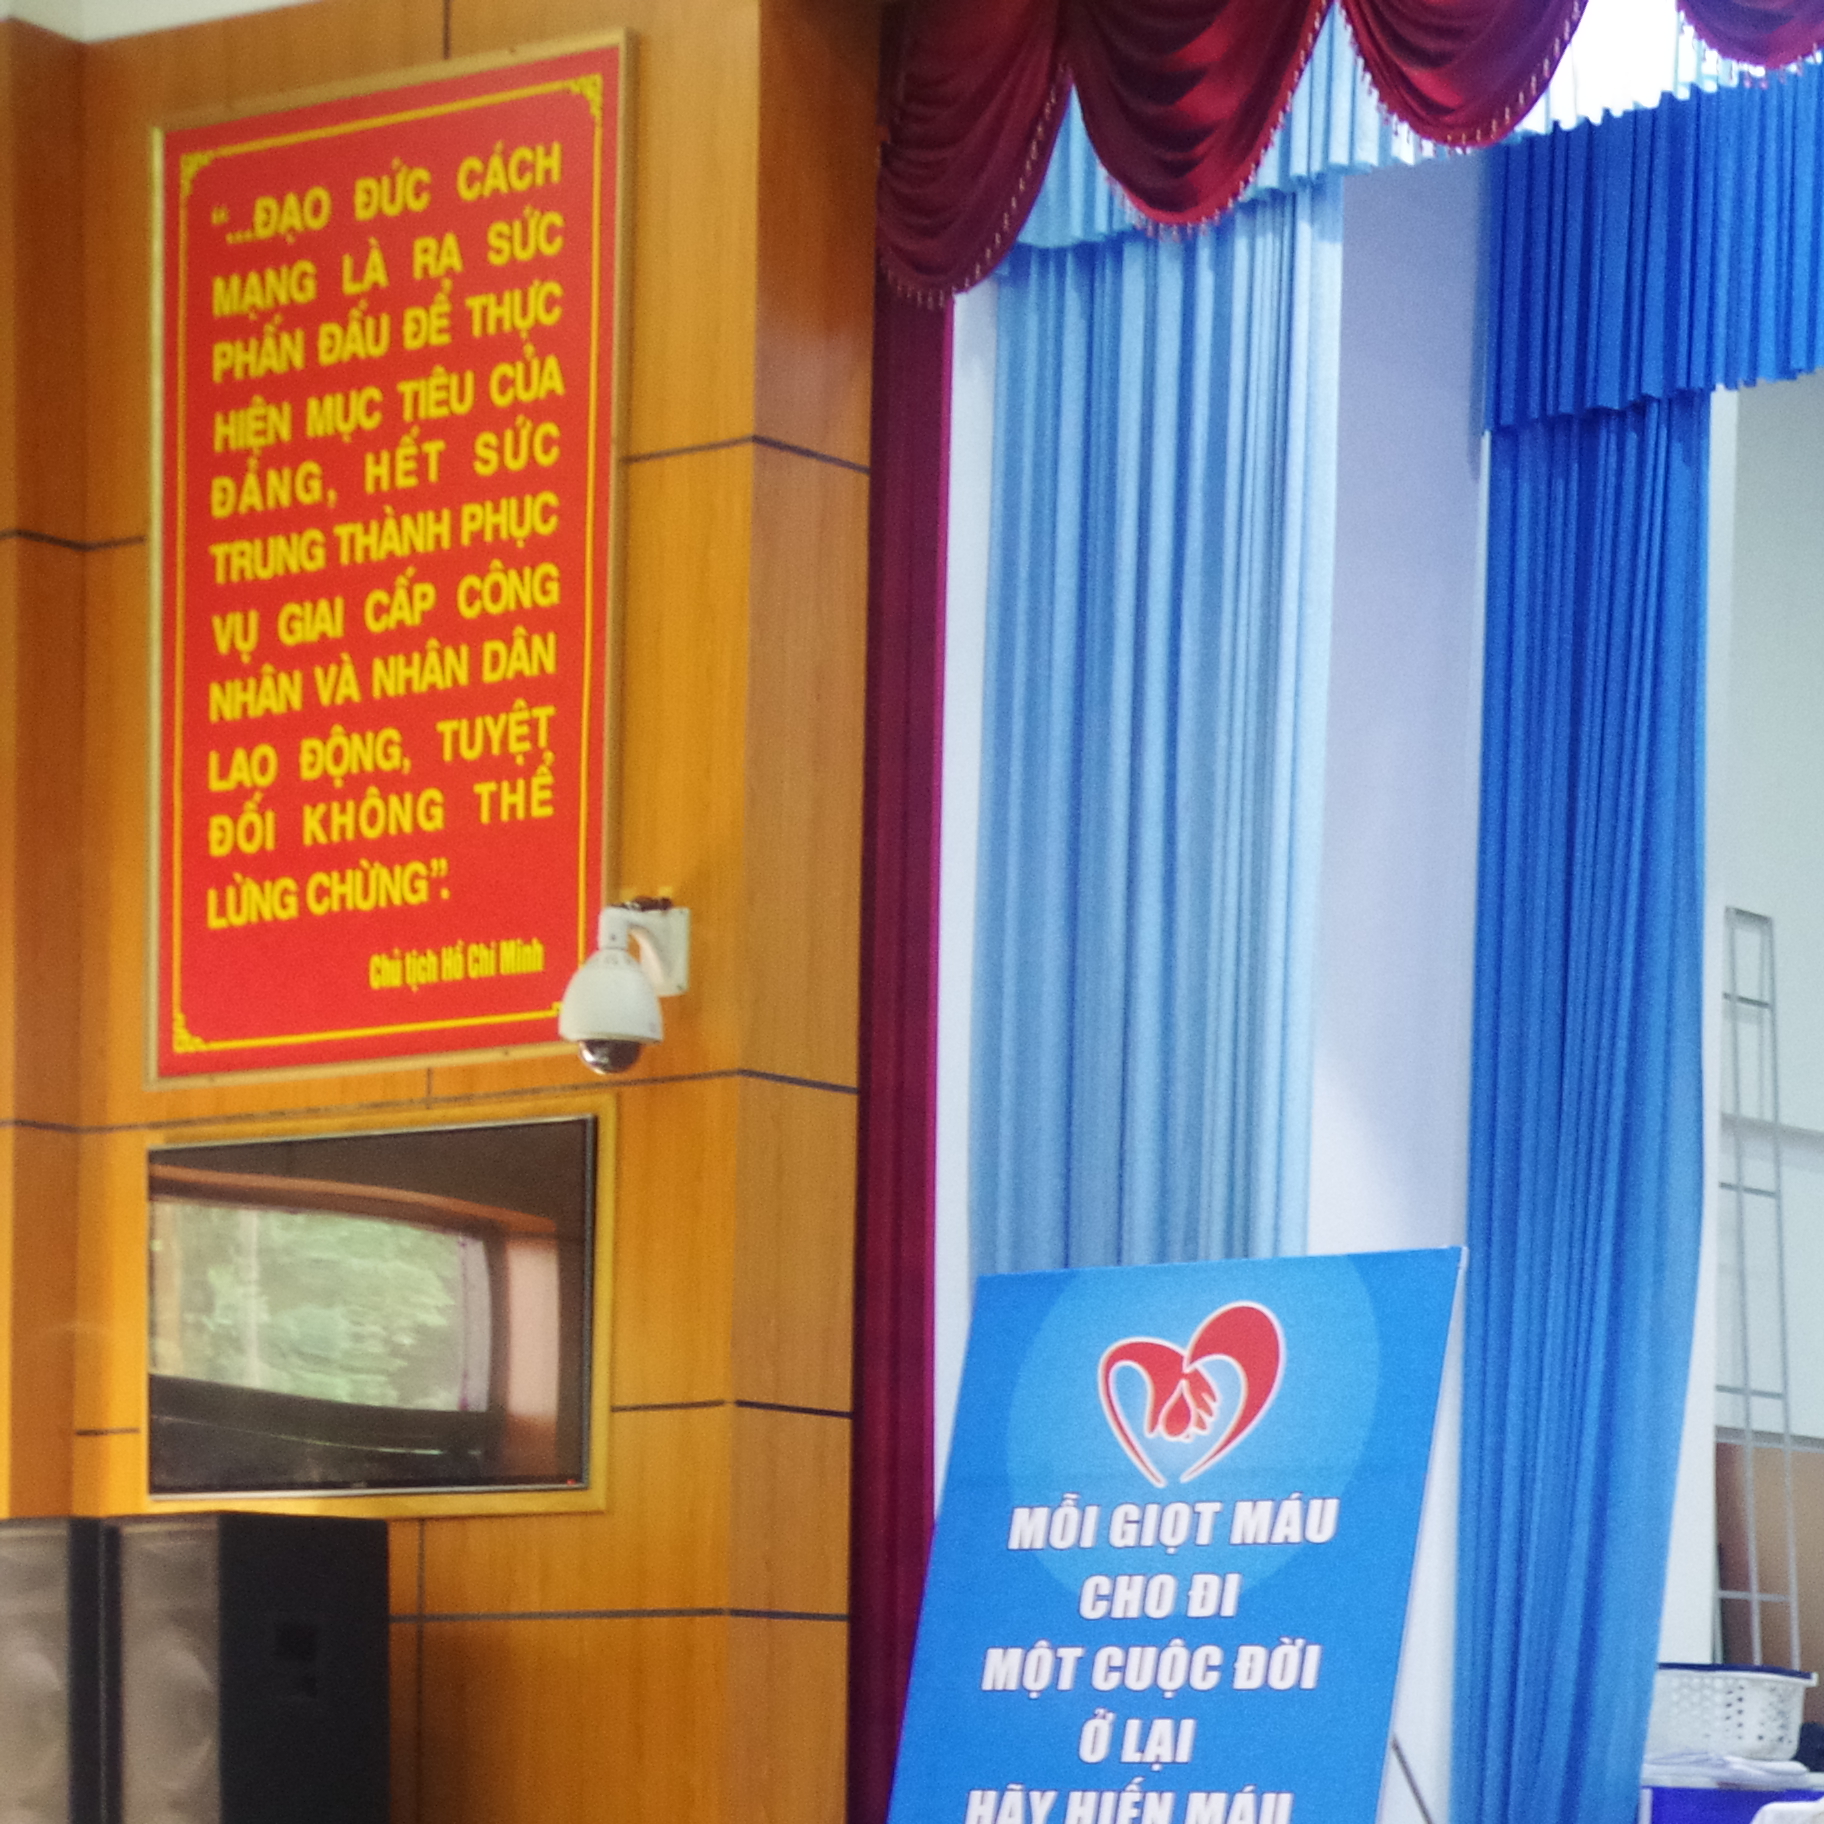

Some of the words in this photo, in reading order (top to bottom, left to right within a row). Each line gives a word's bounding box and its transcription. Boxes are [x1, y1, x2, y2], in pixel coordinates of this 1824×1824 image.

[354, 157, 431, 221] ĐỨC
[457, 140, 562, 202] CÁCH
[213, 260, 316, 321] MẠNG
[342, 236, 387, 295] LÀ
[413, 233, 462, 280] RA
[487, 204, 564, 266] SỨC
[213, 313, 305, 384] PHẤN
[318, 299, 390, 367] ĐẤU
[404, 278, 452, 351] ĐỂ
[466, 280, 563, 341] THỰC
[214, 395, 291, 457] HIỆN
[306, 387, 382, 442] MỤC
[397, 365, 474, 423] TIÊU
[489, 343, 565, 407] CỦA
[211, 453, 337, 519] ĐẢNG,
[365, 425, 445, 494] HẾT
[474, 414, 560, 476] SỨC
[210, 530, 325, 585] TRUNG
[334, 505, 451, 566] THÀNH
[460, 491, 559, 548] PHỤC
[212, 610, 258, 664] VỤ
[278, 596, 344, 647] GIAI
[364, 566, 436, 634] CẤP
[457, 559, 560, 619] CÔNG
[209, 664, 302, 723] NHÂN
[315, 653, 360, 706] VÀ
[372, 638, 469, 699] NHÂN
[481, 625, 556, 684] DÂN
[209, 743, 278, 792] LAO
[300, 725, 411, 787] ĐỘNG,
[437, 699, 555, 764] TUYỆT
[208, 791, 275, 857] ĐỐI
[302, 786, 445, 846] KHÔNG
[474, 751, 554, 824] THỂ
[207, 871, 298, 930] LỪNG
[500, 937, 544, 976] Minh
[1008, 1493, 1099, 1551] MỖI
[1107, 1497, 1223, 1555] GIỌT
[1230, 1492, 1340, 1547] MÁU
[1078, 1573, 1177, 1620] CHO
[1186, 1571, 1242, 1618] ĐI
[981, 1640, 1087, 1698] MỘT
[1091, 1640, 1227, 1699] CUỘC
[1233, 1636, 1323, 1690] ĐỜI
[1077, 1706, 1115, 1764] Ở
[1120, 1718, 1195, 1769] LẠI
